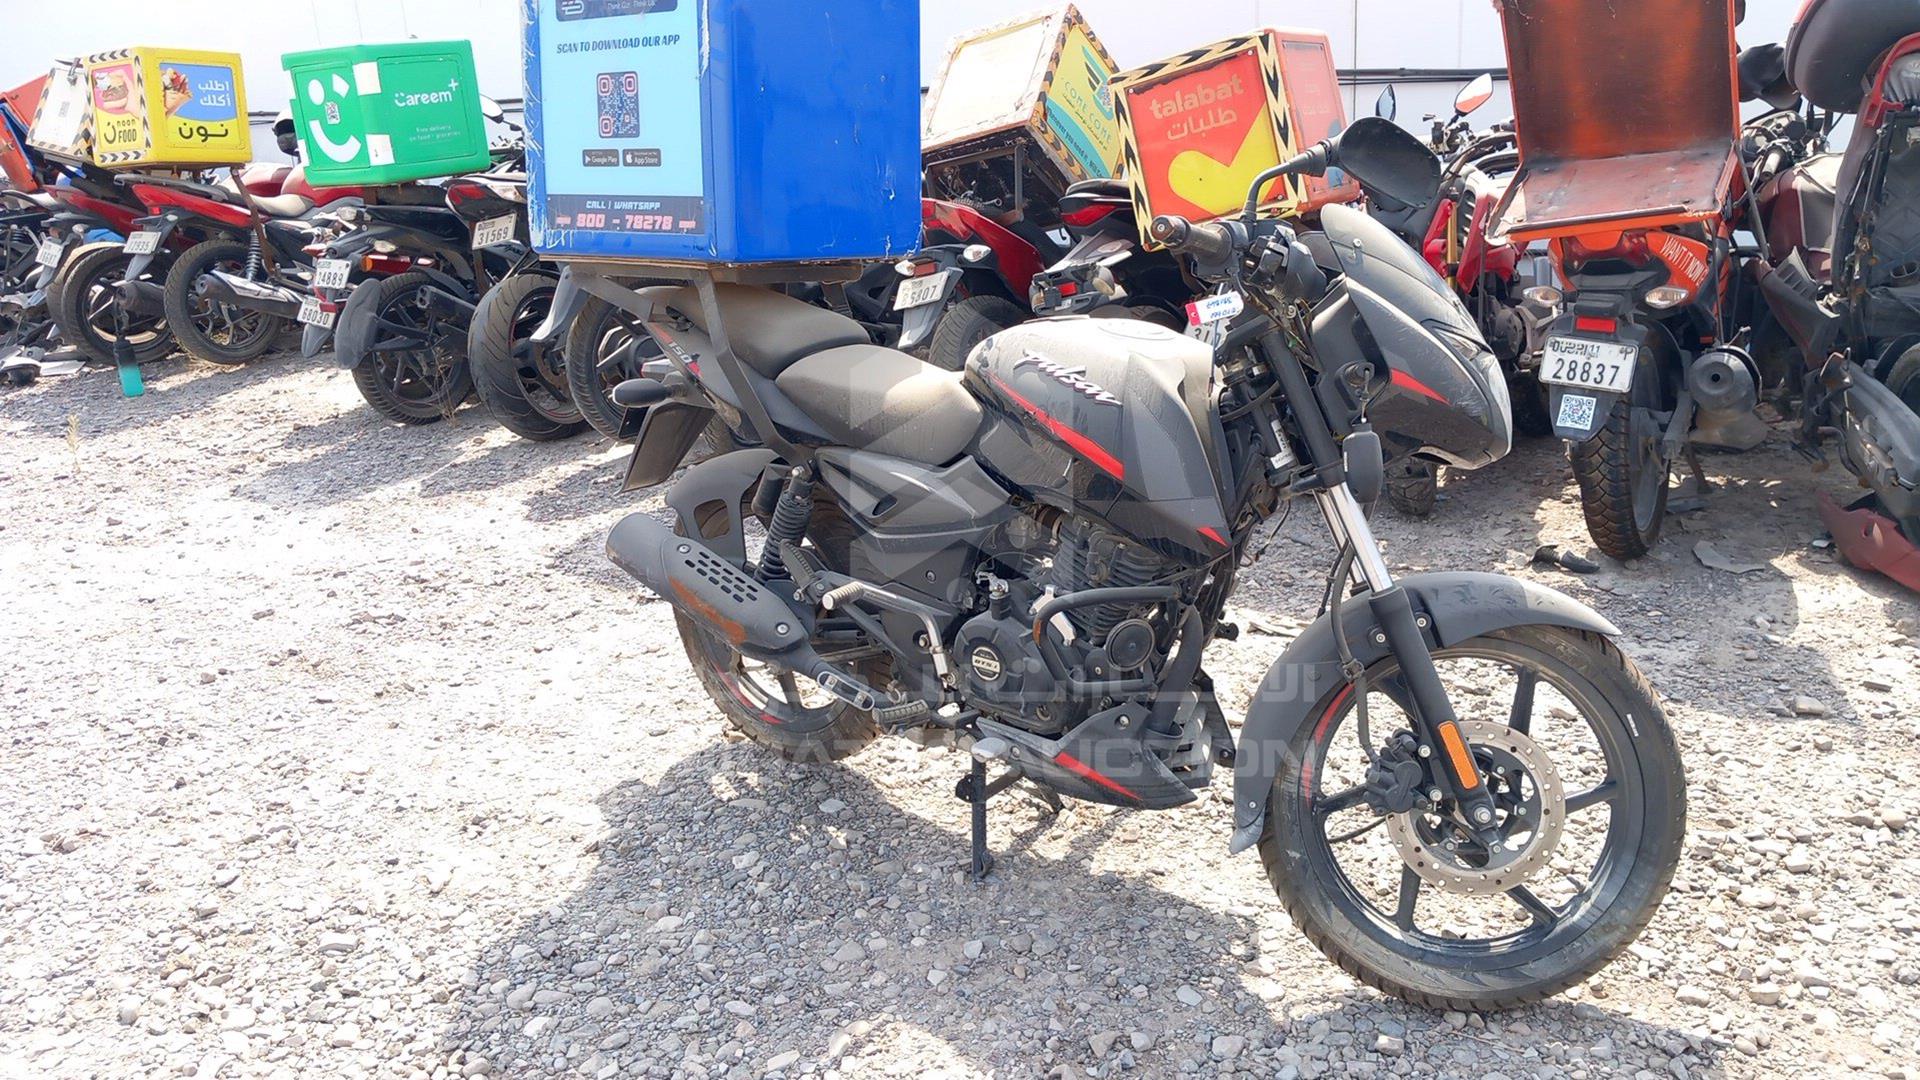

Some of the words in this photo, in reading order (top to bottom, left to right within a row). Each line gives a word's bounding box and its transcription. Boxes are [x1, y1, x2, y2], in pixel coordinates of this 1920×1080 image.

[557, 43, 579, 54] SCAN
[580, 41, 591, 52] TO
[592, 37, 640, 51] DOWNLOAD
[641, 36, 660, 47] OUR
[662, 34, 680, 46] APP
[198, 79, 230, 92] اطلب
[1065, 81, 1088, 113] COME
[1150, 73, 1244, 120] talabat
[116, 118, 136, 127] noon
[1167, 106, 1238, 141] طلبات
[118, 129, 137, 143] FOOD
[586, 201, 606, 209] CALL
[614, 202, 661, 210] WHATSAPP
[576, 213, 606, 228] 800
[478, 227, 509, 245] 31569
[1660, 235, 1687, 265] WANT
[669, 341, 693, 364] 150
[1552, 358, 1620, 386] 28837
